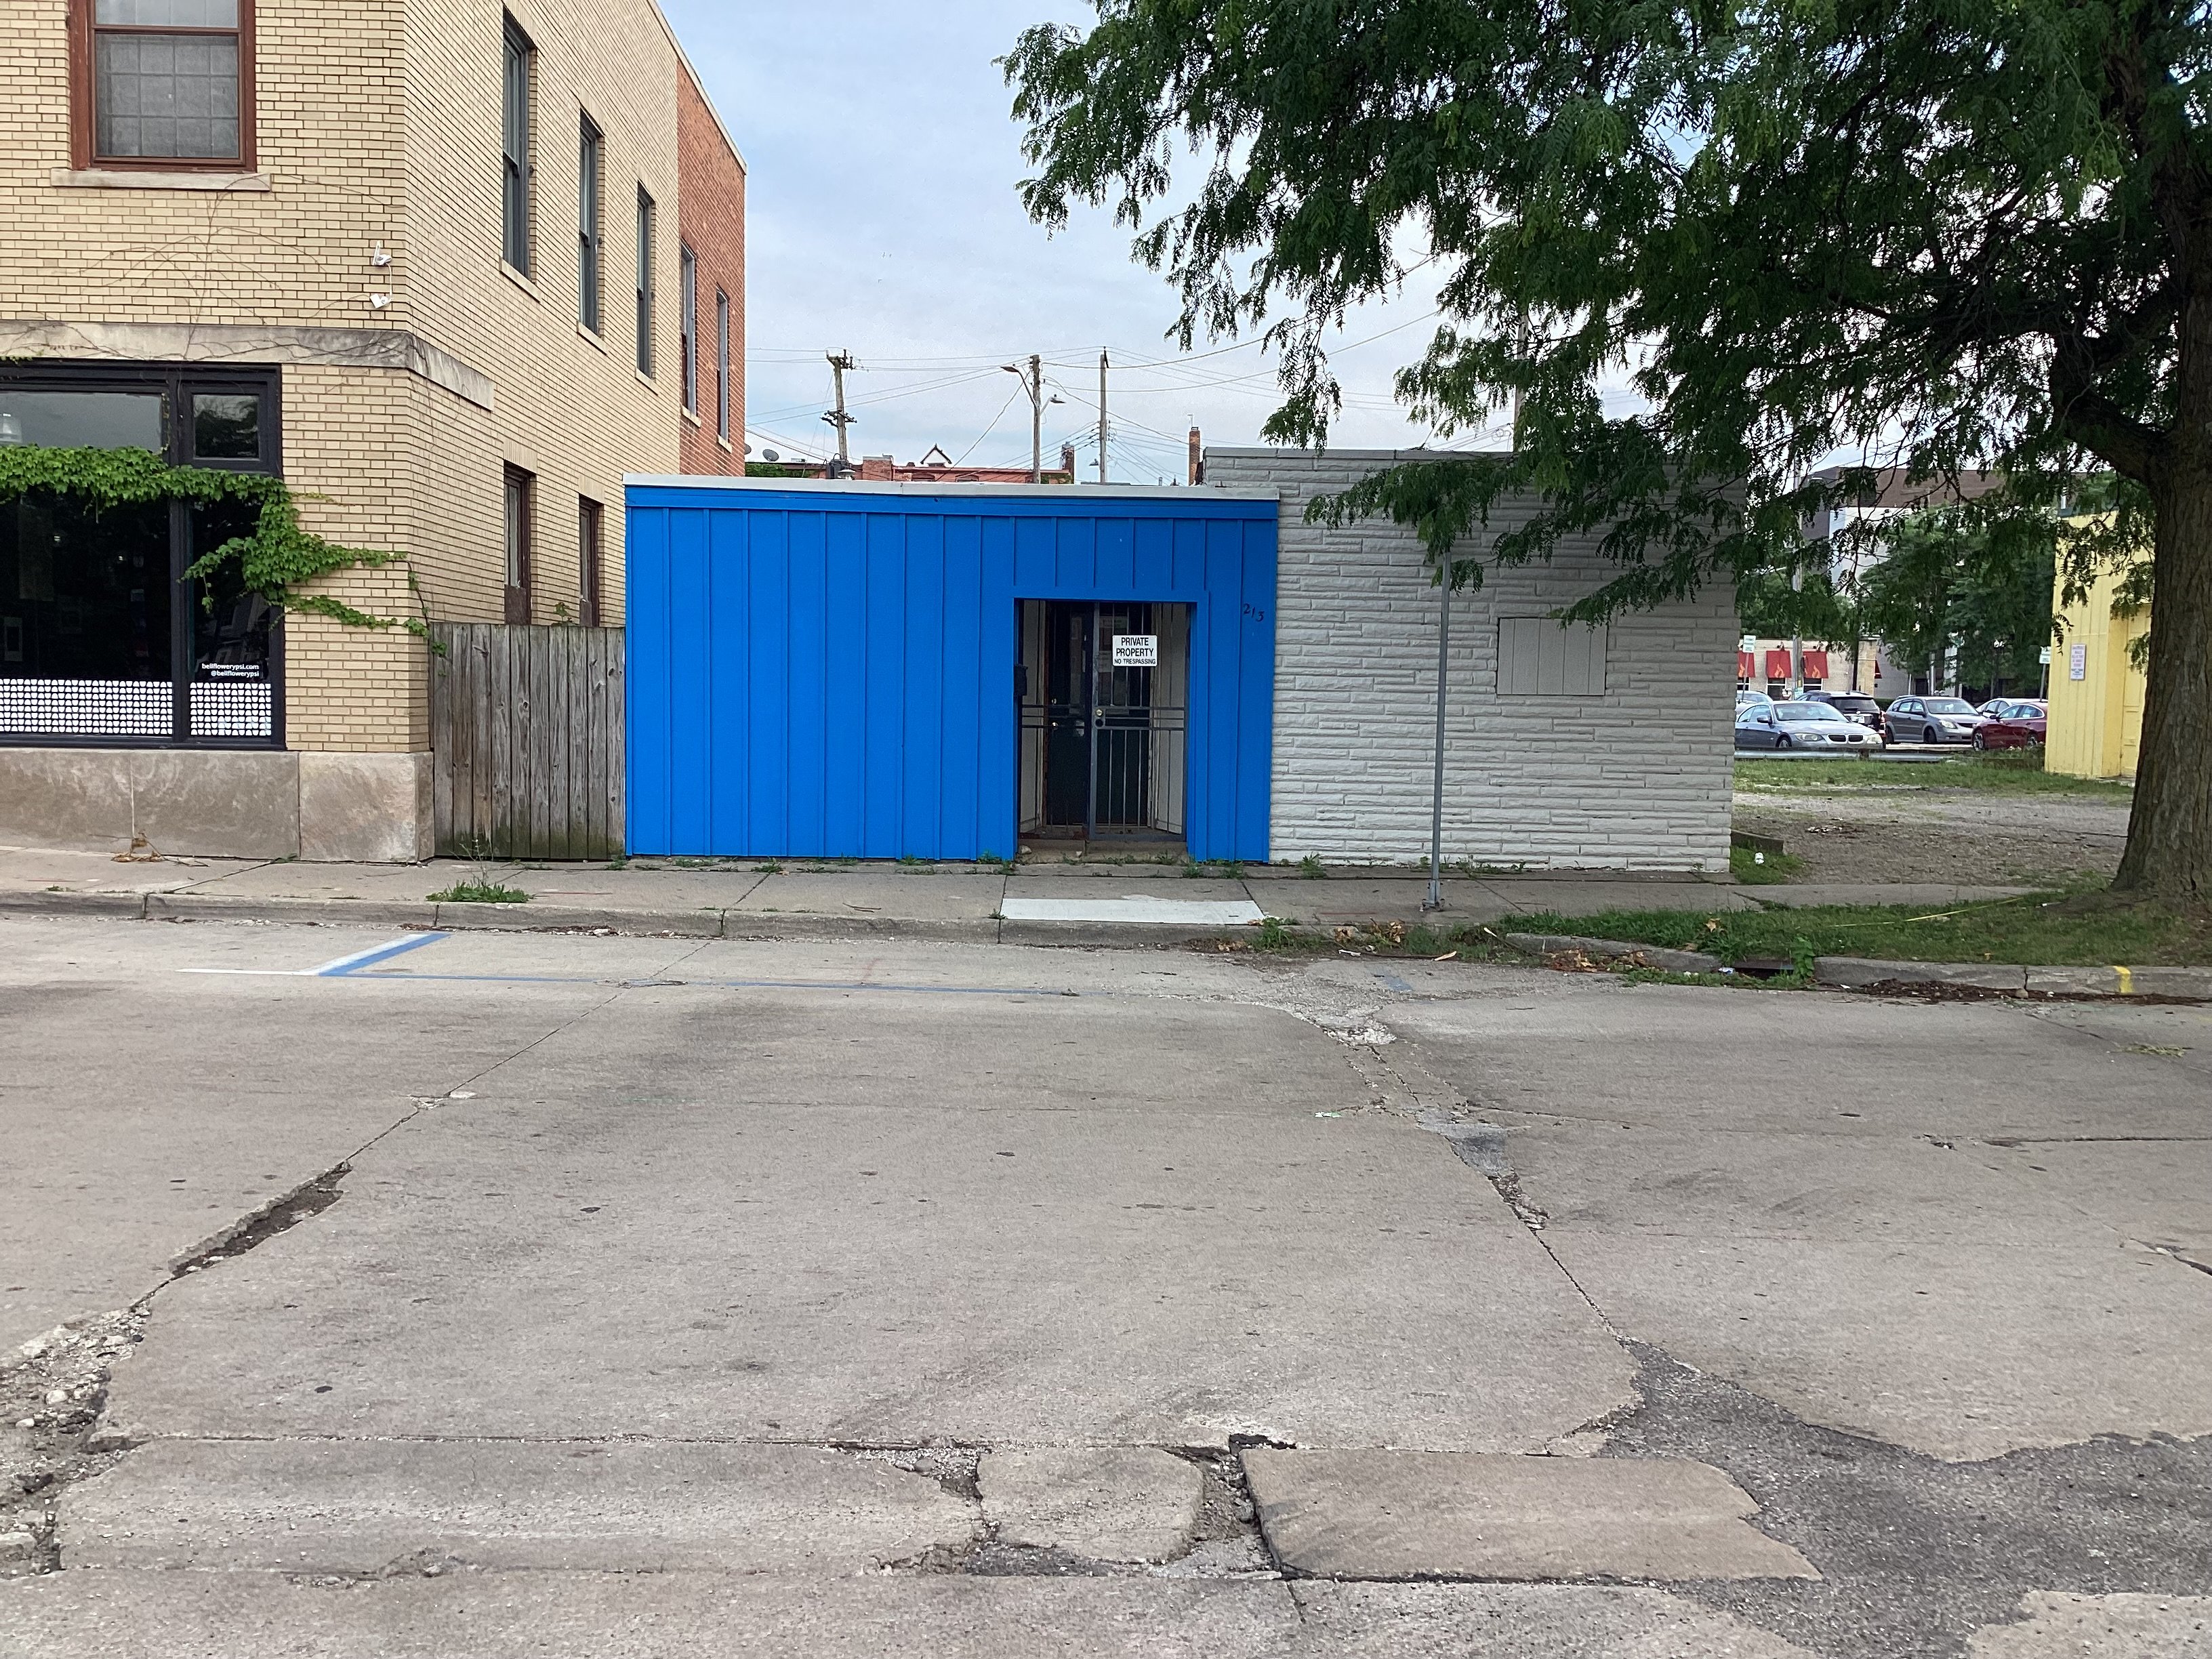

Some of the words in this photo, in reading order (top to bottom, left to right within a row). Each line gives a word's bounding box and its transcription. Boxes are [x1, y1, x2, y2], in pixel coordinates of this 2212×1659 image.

[1244, 602, 1265, 622] 213
[1121, 637, 1149, 646] PRIVATE
[1116, 648, 1153, 657] PROPERTY
